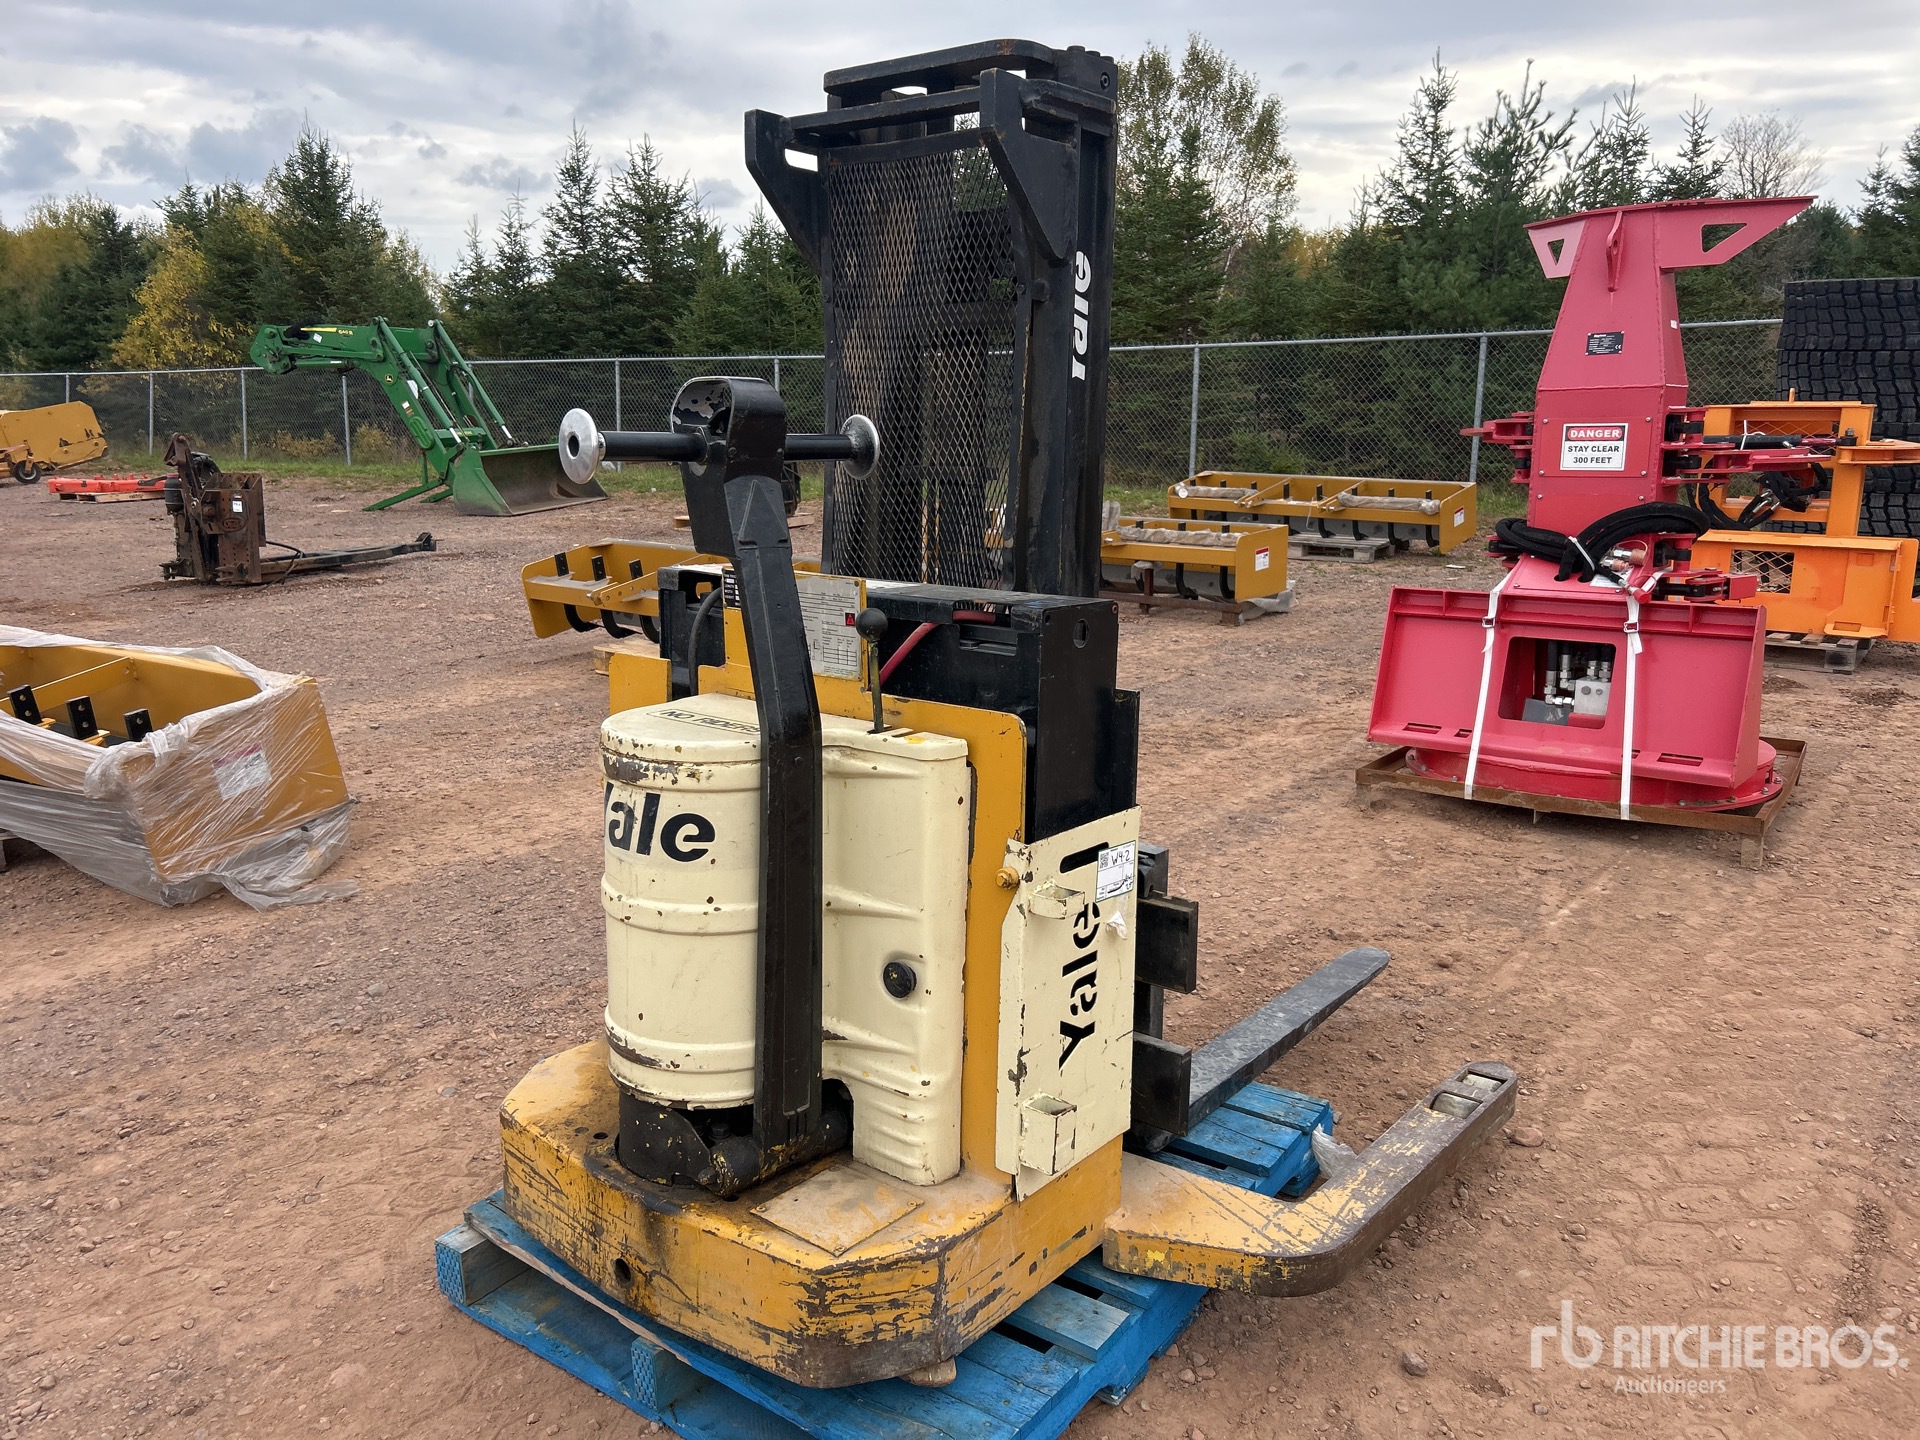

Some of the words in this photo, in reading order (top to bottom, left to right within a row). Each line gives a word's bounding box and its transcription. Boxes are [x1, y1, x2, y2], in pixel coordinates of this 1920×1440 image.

[1570, 429, 1620, 438] DANGER
[1567, 445, 1589, 453] STAY
[1591, 445, 1620, 453] CLEAR
[1573, 456, 1589, 464] 300
[1590, 456, 1612, 464] FEET
[660, 711, 695, 719] NO
[1058, 902, 1100, 1071] Yale
